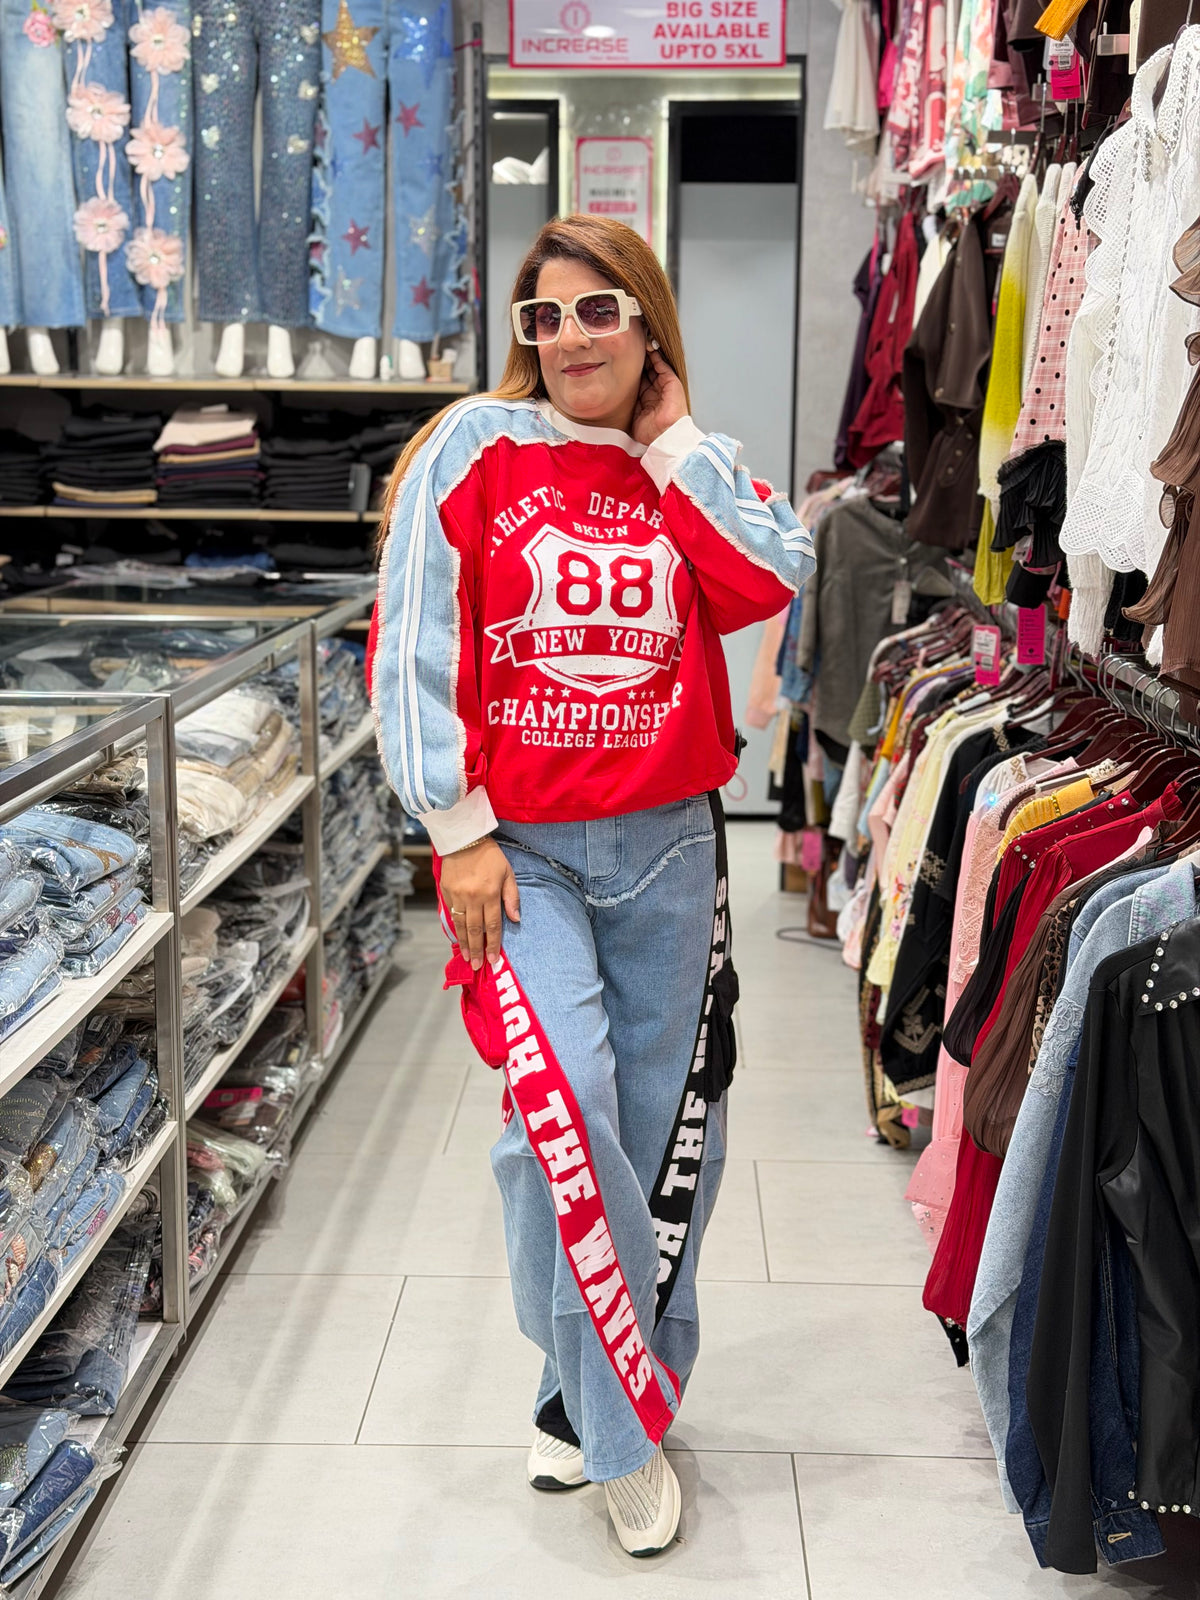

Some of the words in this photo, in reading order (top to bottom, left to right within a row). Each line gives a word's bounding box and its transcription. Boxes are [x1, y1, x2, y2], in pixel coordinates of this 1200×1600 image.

[666, 2, 703, 18] BIG
[711, 2, 758, 18] SIZE
[654, 23, 770, 39] AVAILABLE
[521, 38, 629, 54] INCREASE
[660, 44, 717, 59] UPTO
[724, 44, 763, 59] 5XL
[572, 521, 629, 539] BKLYN
[556, 550, 653, 618] 88
[532, 628, 586, 654] NEW
[608, 628, 669, 659] YORK
[487, 681, 683, 731] CHAMPIONSHP
[521, 730, 595, 748] COLLEGE
[527, 1088, 598, 1216] THE
[568, 1215, 653, 1401] WAVES
